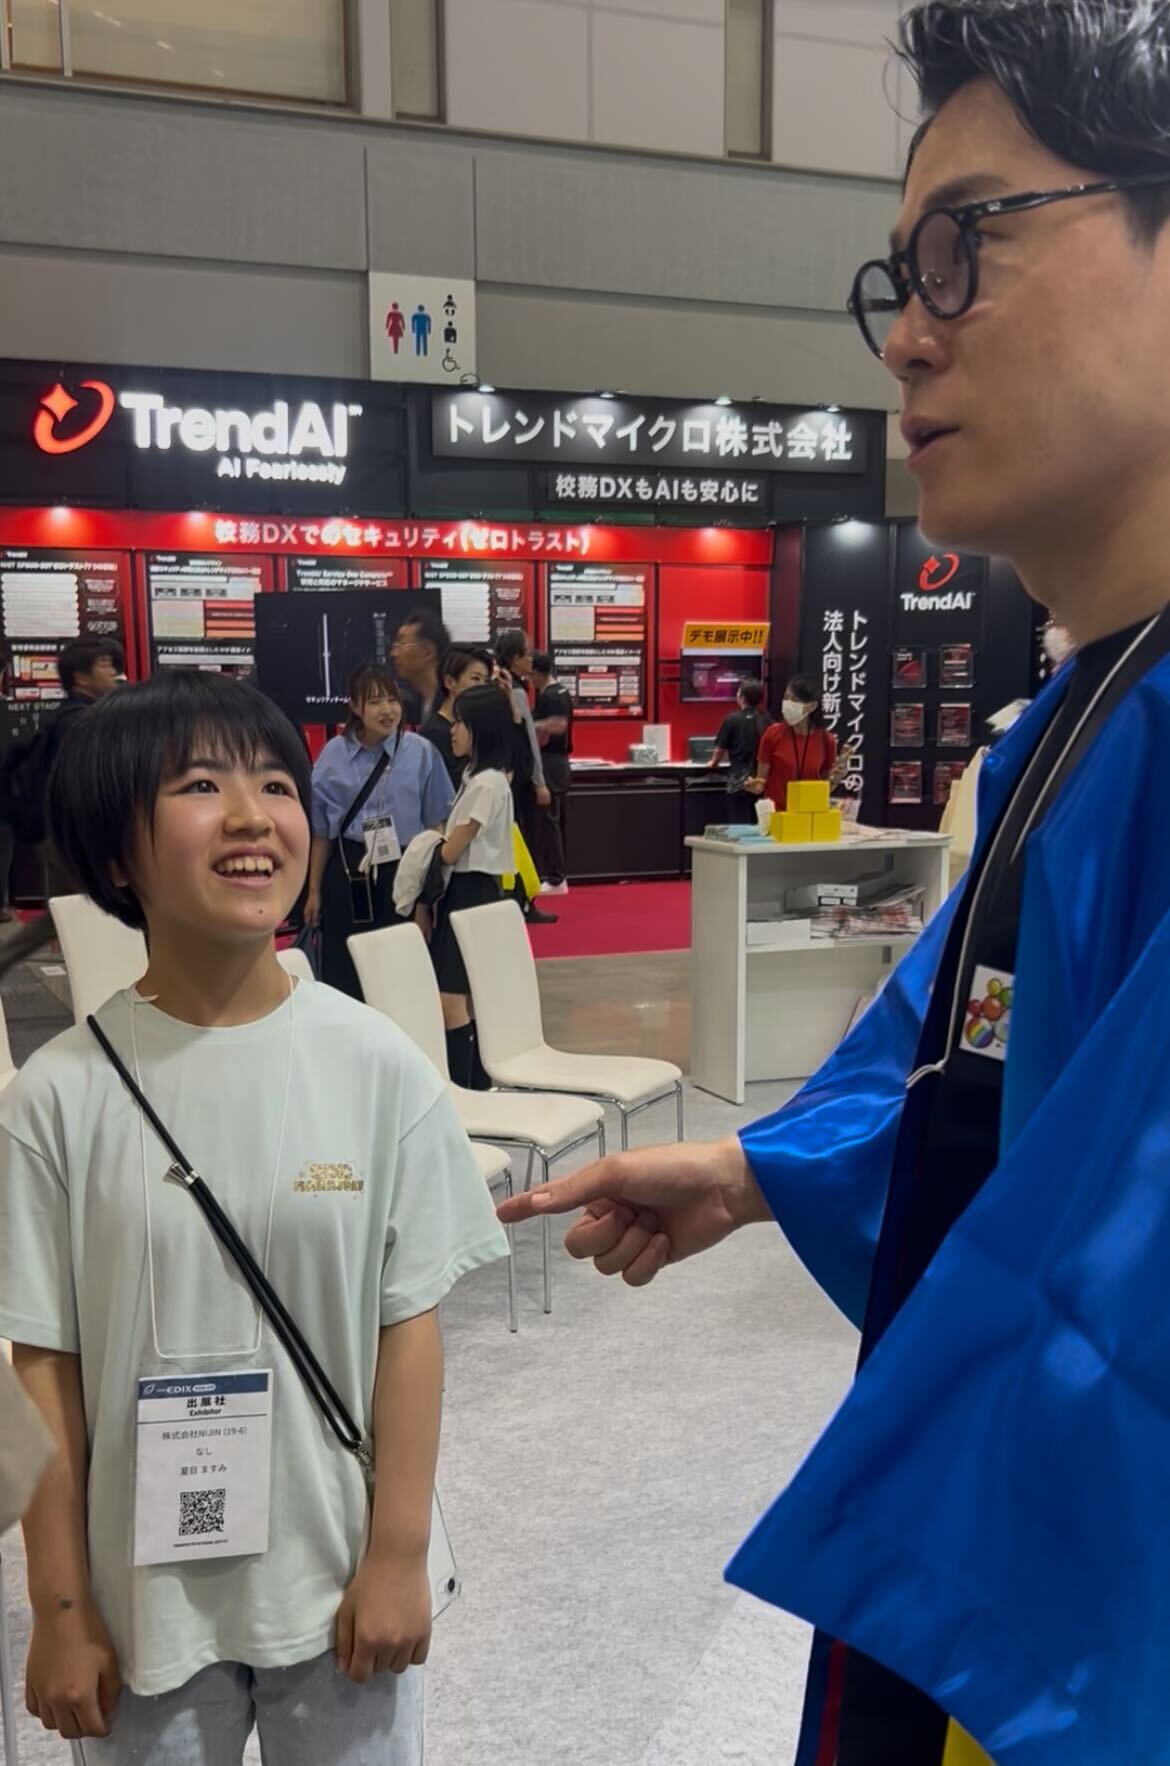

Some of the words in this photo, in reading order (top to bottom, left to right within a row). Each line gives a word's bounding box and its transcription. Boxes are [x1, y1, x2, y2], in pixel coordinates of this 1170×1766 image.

[448, 404, 853, 461] トレンドマイクロ株式会社
[217, 457, 241, 479] AI
[556, 474, 759, 504] 校務DXもAIも安心に
[689, 630, 764, 644] デモ展示中!!
[822, 610, 844, 744] 法人向け新ブ
[847, 610, 868, 791] トレンドマイクロの
[187, 1396, 226, 1408] 出展社
[189, 1408, 221, 1417] Exhibitor
[162, 1428, 222, 1440] 株式会社NIJIN
[196, 1447, 214, 1456] なし
